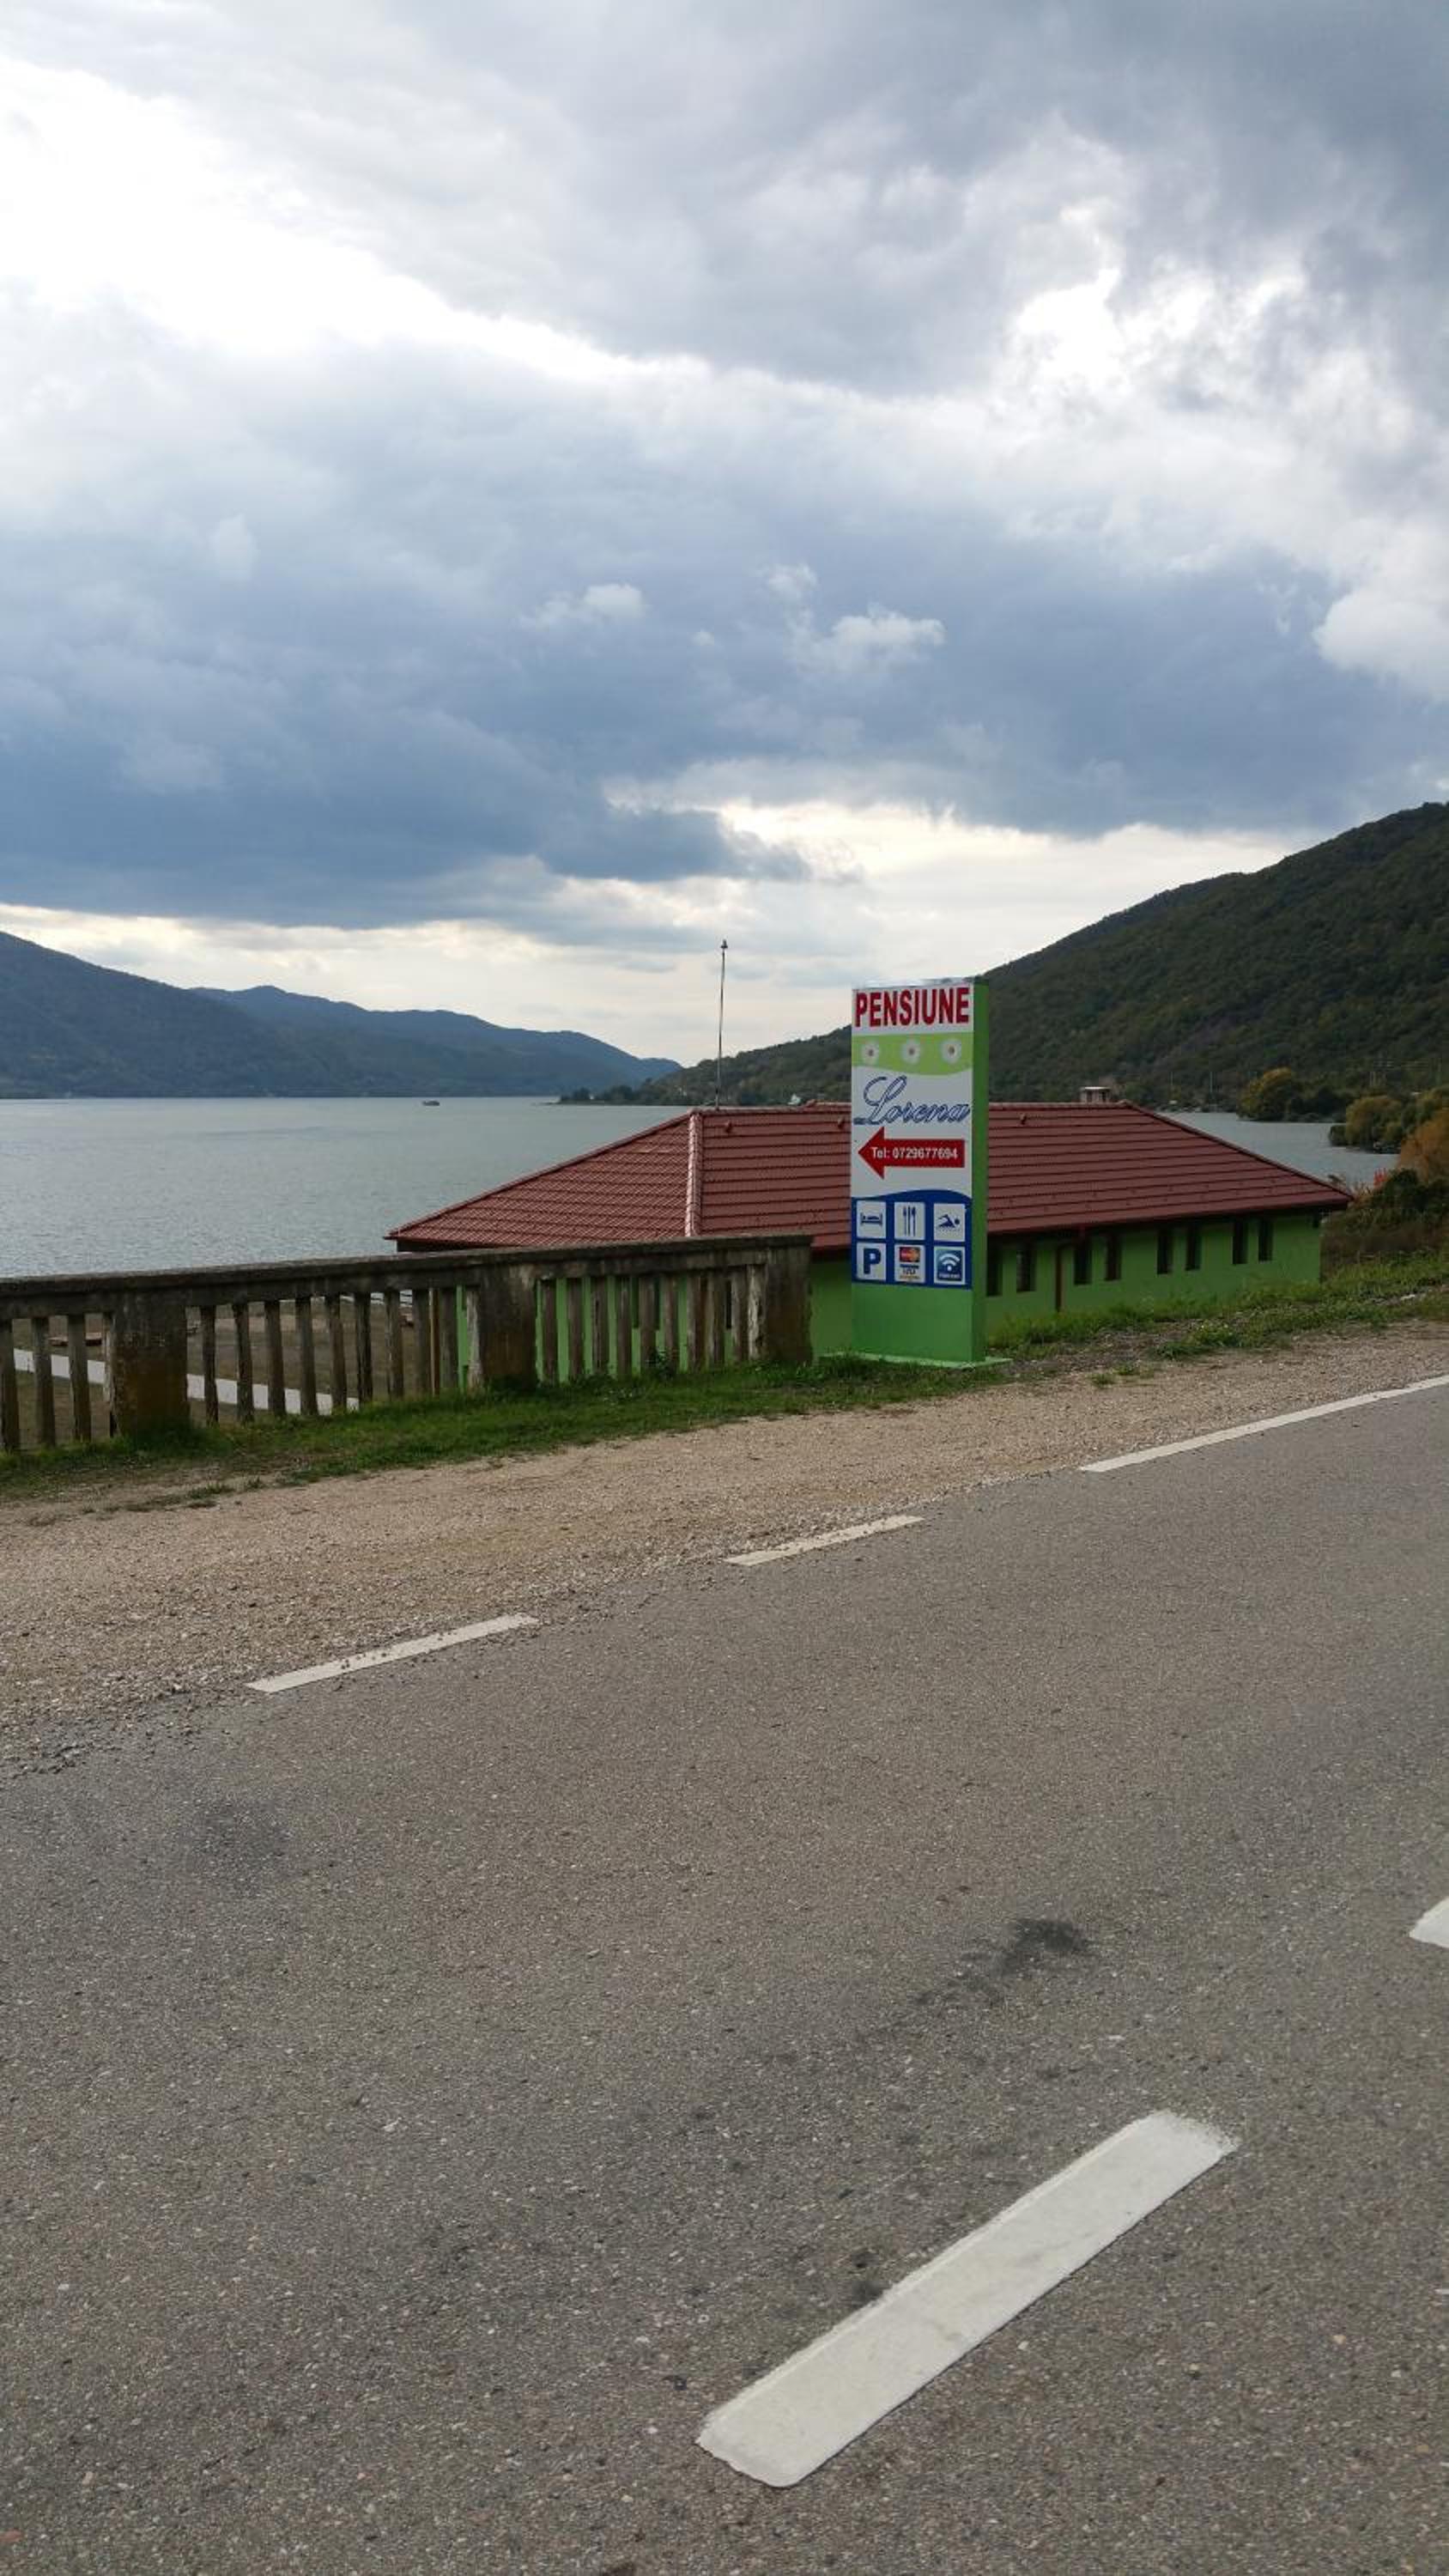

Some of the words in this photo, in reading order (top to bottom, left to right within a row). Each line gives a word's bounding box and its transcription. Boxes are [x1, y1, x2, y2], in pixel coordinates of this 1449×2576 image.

[855, 987, 970, 1027] PENSIUNE
[853, 1075, 971, 1126] Lorena
[870, 1146, 890, 1158] Tel:
